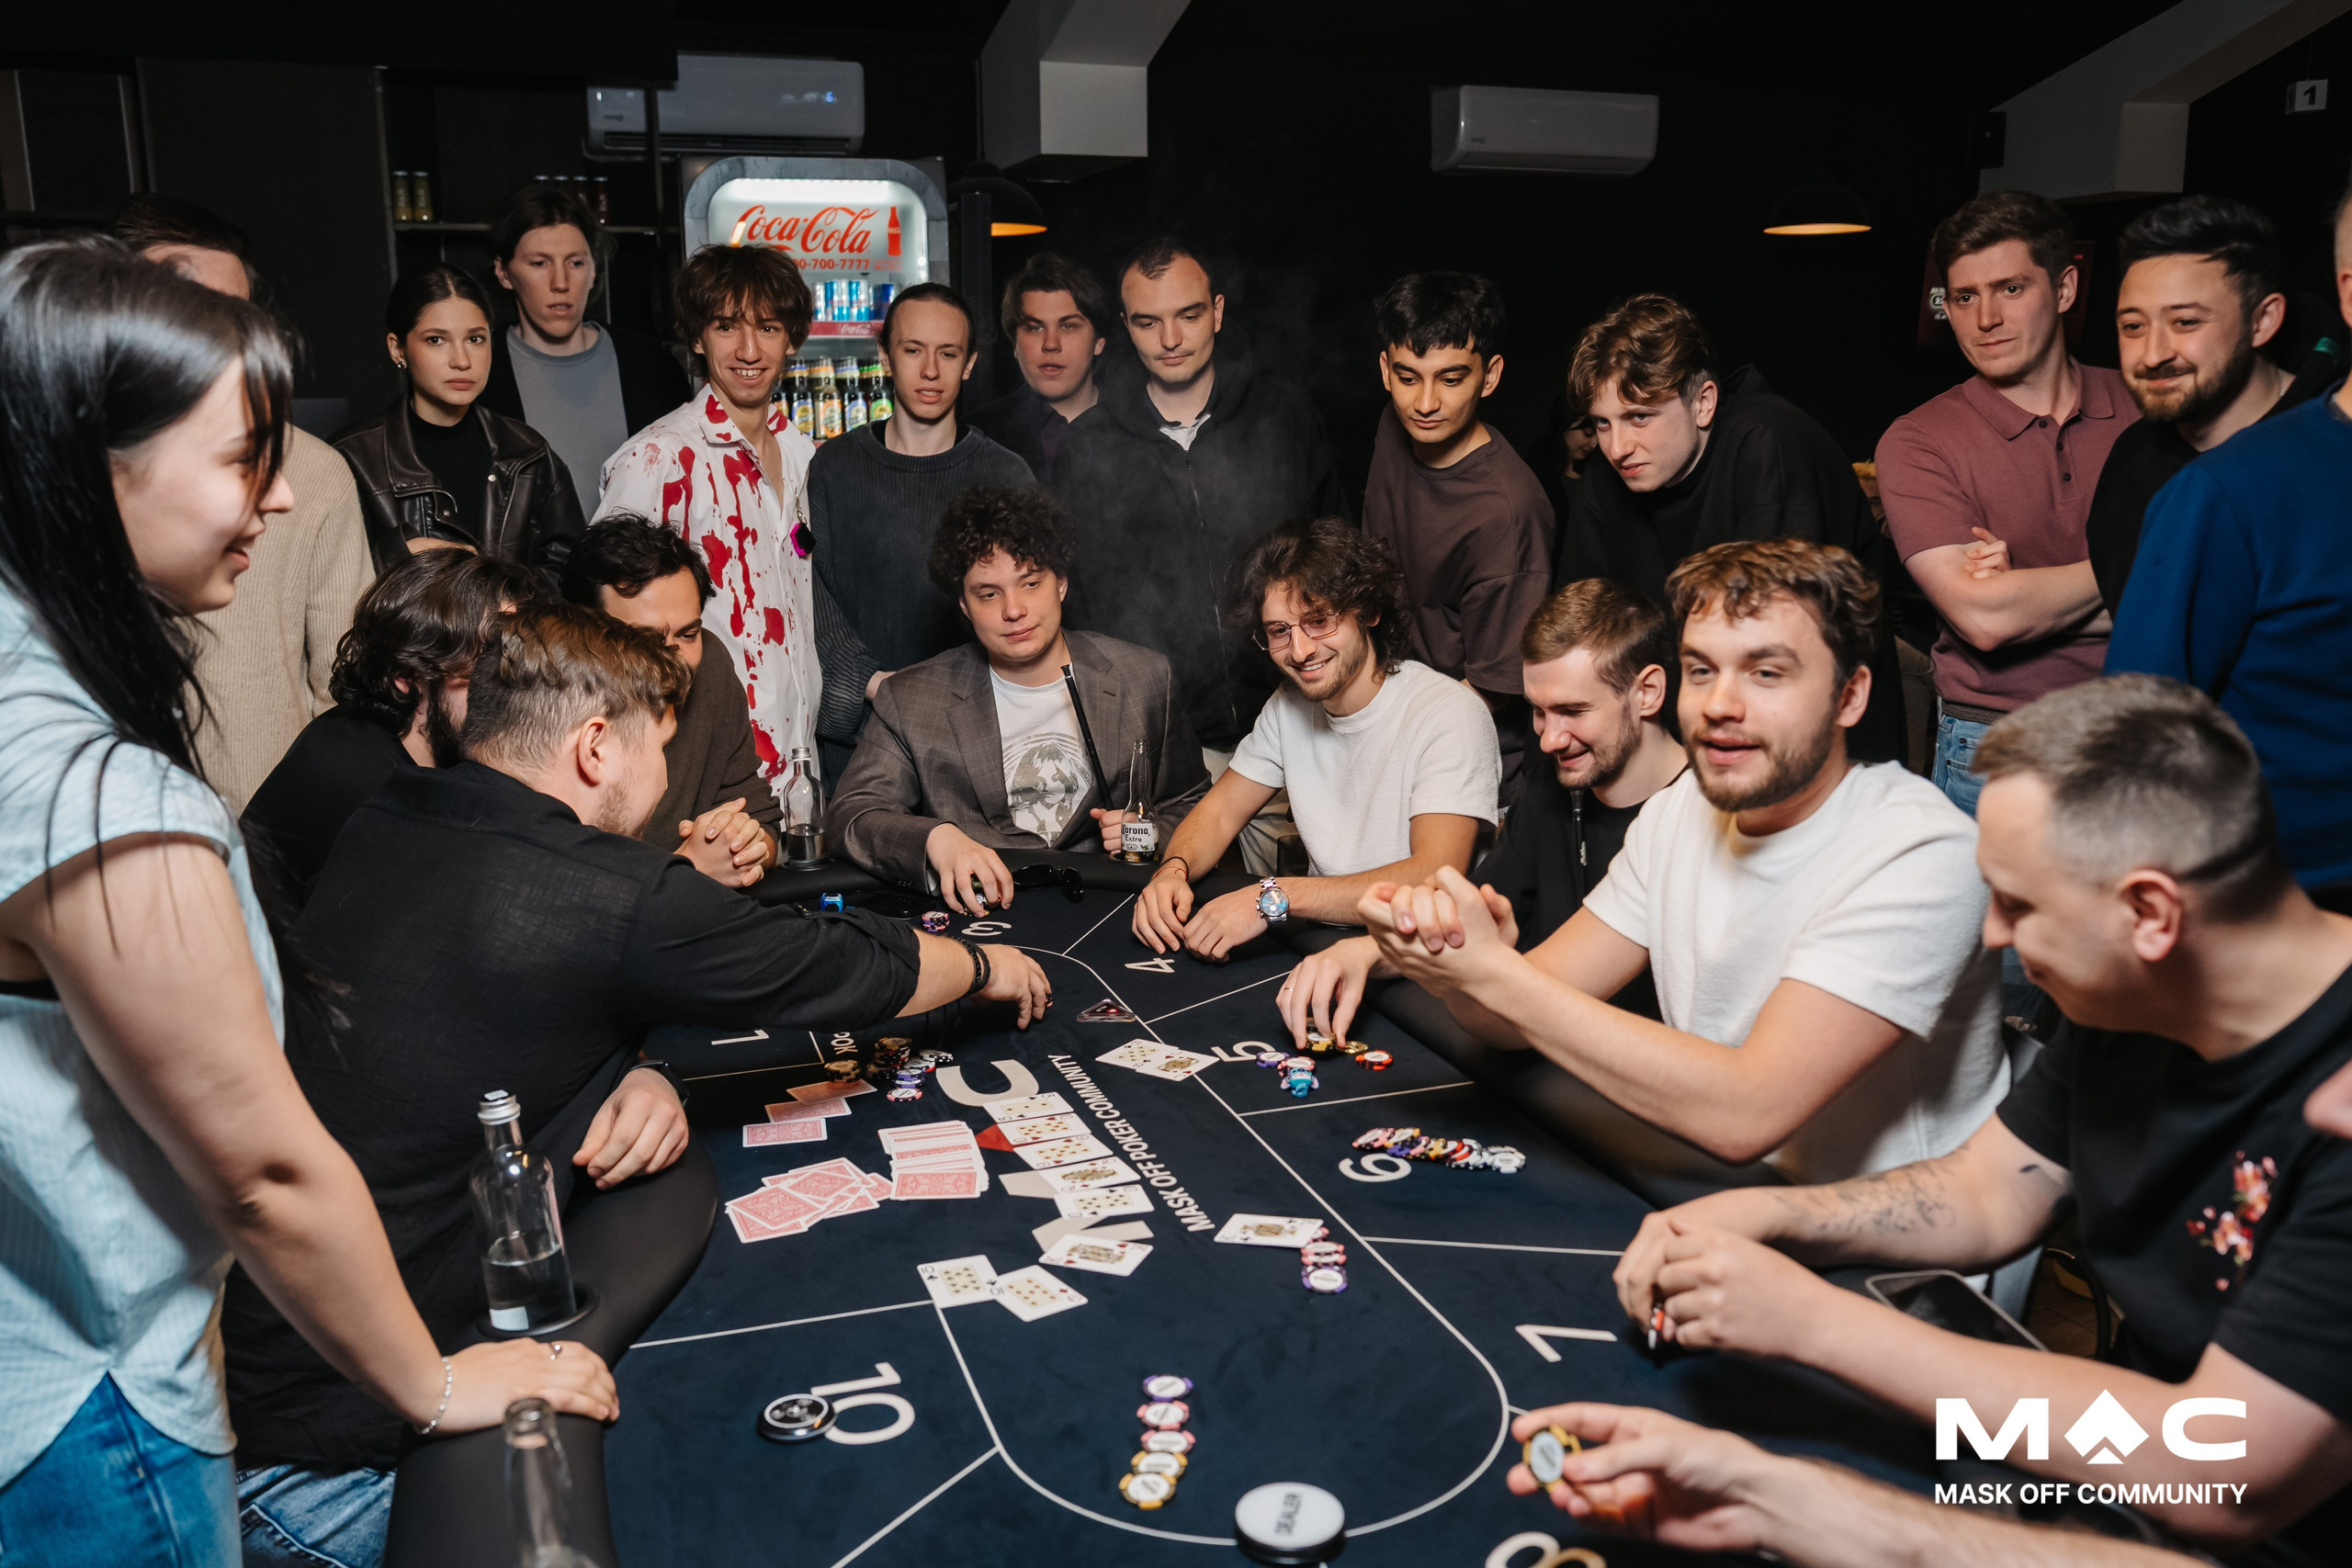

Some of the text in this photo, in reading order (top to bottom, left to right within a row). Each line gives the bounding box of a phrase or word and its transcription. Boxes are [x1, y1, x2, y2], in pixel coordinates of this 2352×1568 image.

[2303, 85, 2316, 106] 1
[1122, 825, 1148, 834] Corona
[962, 921, 1012, 937] 3
[1125, 957, 1175, 974] 4
[1211, 1041, 1276, 1063] 5
[1047, 1055, 1216, 1232] MASK OFF POKER COMMUNITY
[920, 1265, 935, 1274] 10
[1515, 1324, 1618, 1362] 7
[810, 1361, 915, 1445] 10
